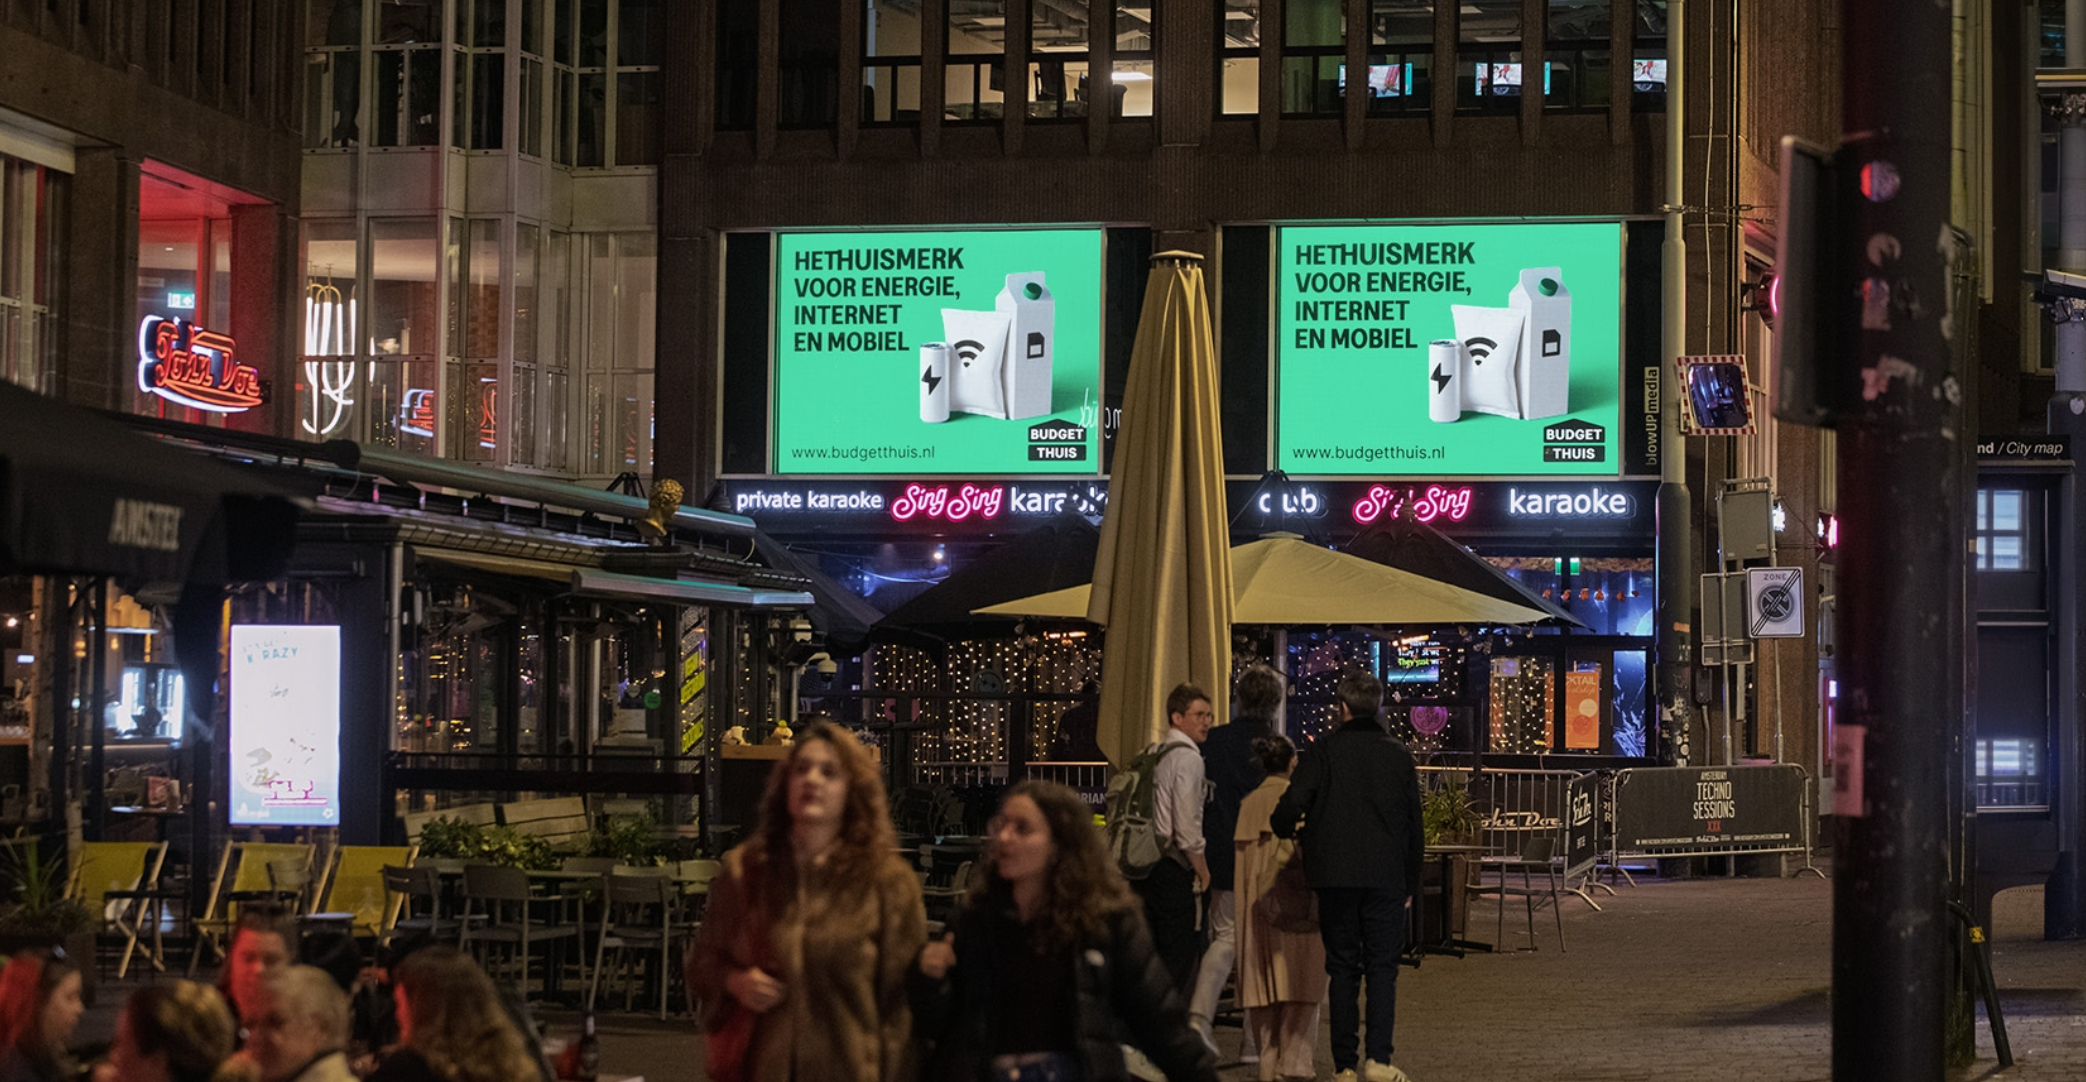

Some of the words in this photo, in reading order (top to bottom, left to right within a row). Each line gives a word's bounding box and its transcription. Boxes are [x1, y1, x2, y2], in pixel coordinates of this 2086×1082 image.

[794, 277, 857, 298] VOOR
[861, 275, 961, 300] ENERGIE,
[1294, 271, 1361, 294] VOOR
[1366, 271, 1472, 296] ENERGIE,
[794, 304, 903, 325] INTERNET
[1295, 300, 1411, 322] INTERNET
[794, 331, 823, 352] EN
[827, 331, 910, 352] MOBIEL
[1295, 328, 1326, 349] EN
[1330, 327, 1418, 349] MOBIEL
[1646, 369, 1657, 412] media
[1030, 427, 1085, 440] BUDGET
[1546, 428, 1603, 441] BUDGET
[1645, 414, 1658, 466] blowUP
[792, 446, 935, 463] www.budgetthuis.nl
[1036, 447, 1078, 459] THUIS
[1292, 445, 1445, 463] www.budgetthuis.nl
[1552, 447, 1596, 460] THUIS
[2006, 441, 2032, 457] City
[2034, 443, 2064, 456] map
[736, 490, 802, 512] private
[808, 489, 883, 509] karaoke
[892, 485, 948, 519] Sing
[947, 485, 1003, 519] Sing
[1258, 487, 1319, 513] cub
[1413, 486, 1471, 522] Sing
[1509, 487, 1627, 514] karaoke
[1696, 781, 1732, 801] TECHNO
[1693, 800, 1736, 820] SESSIONS
